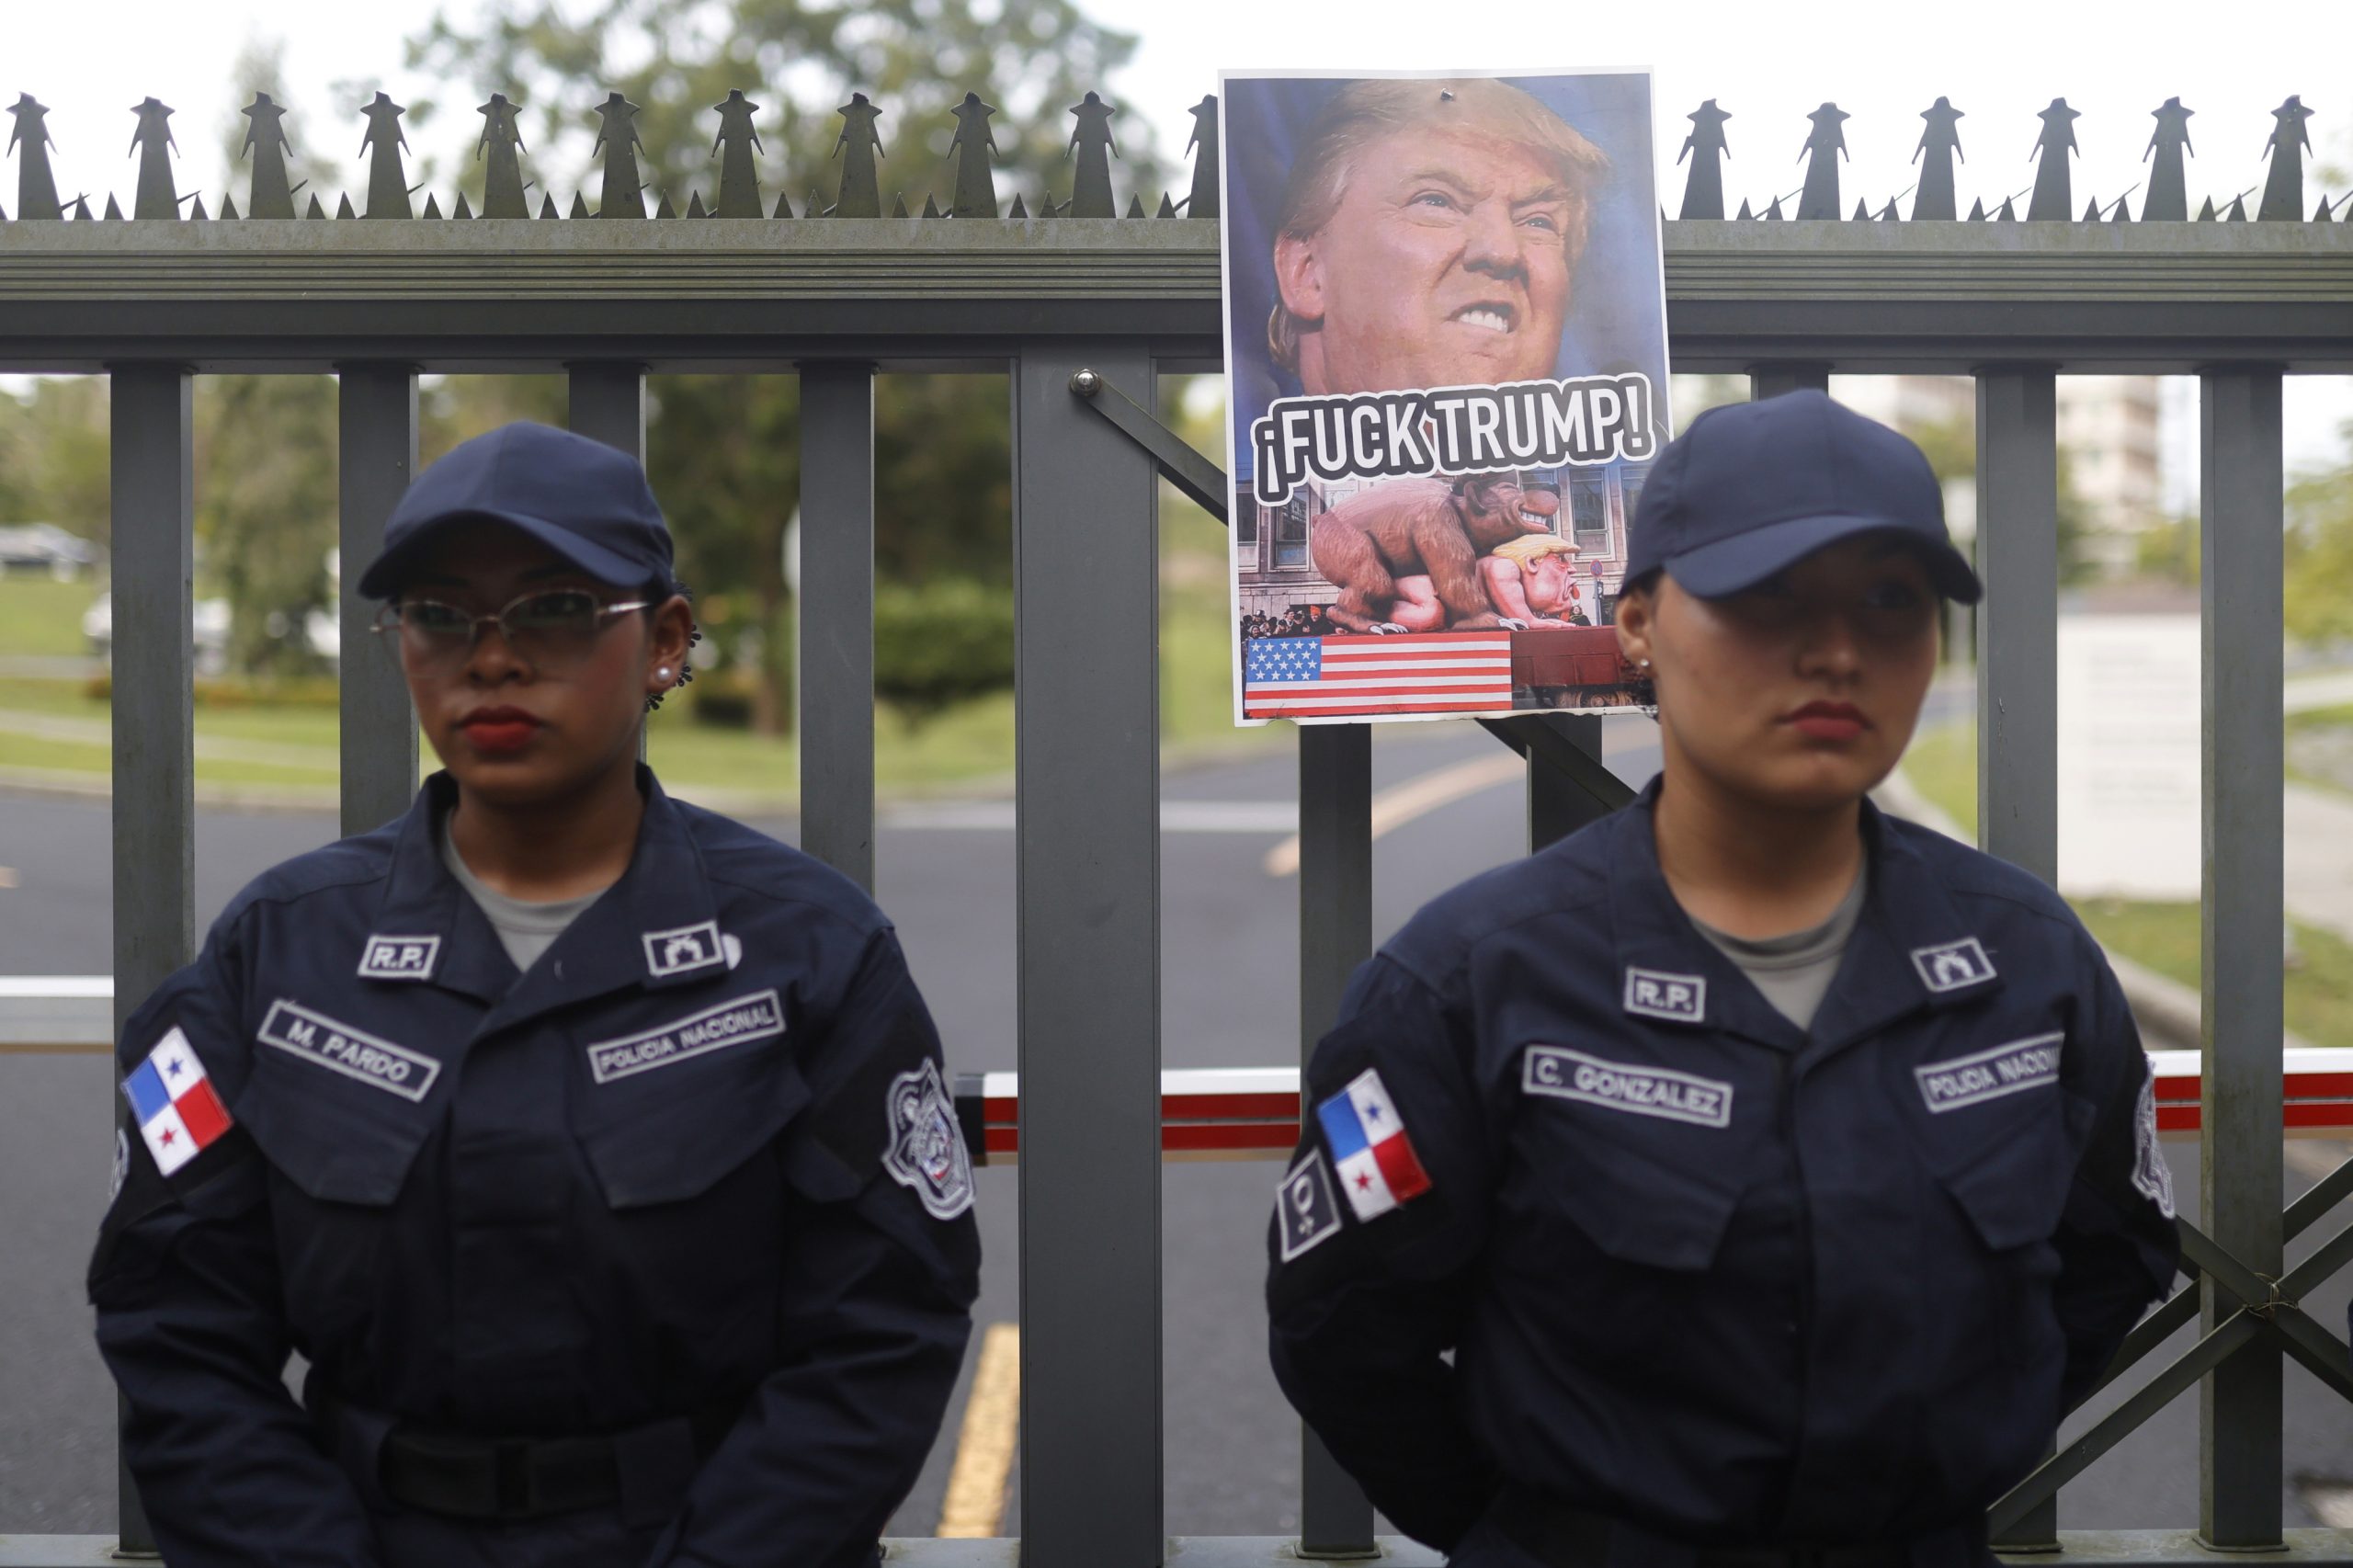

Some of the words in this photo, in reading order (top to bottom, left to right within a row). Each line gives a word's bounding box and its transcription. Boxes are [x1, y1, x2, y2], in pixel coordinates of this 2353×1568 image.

[1433, 384, 1645, 464] TRUMP!
[369, 945, 425, 969] R.P.
[1635, 979, 1695, 1012] R.P.
[678, 1004, 776, 1049] NACIONAL
[286, 1018, 318, 1048] M.
[322, 1032, 413, 1083] PARDO
